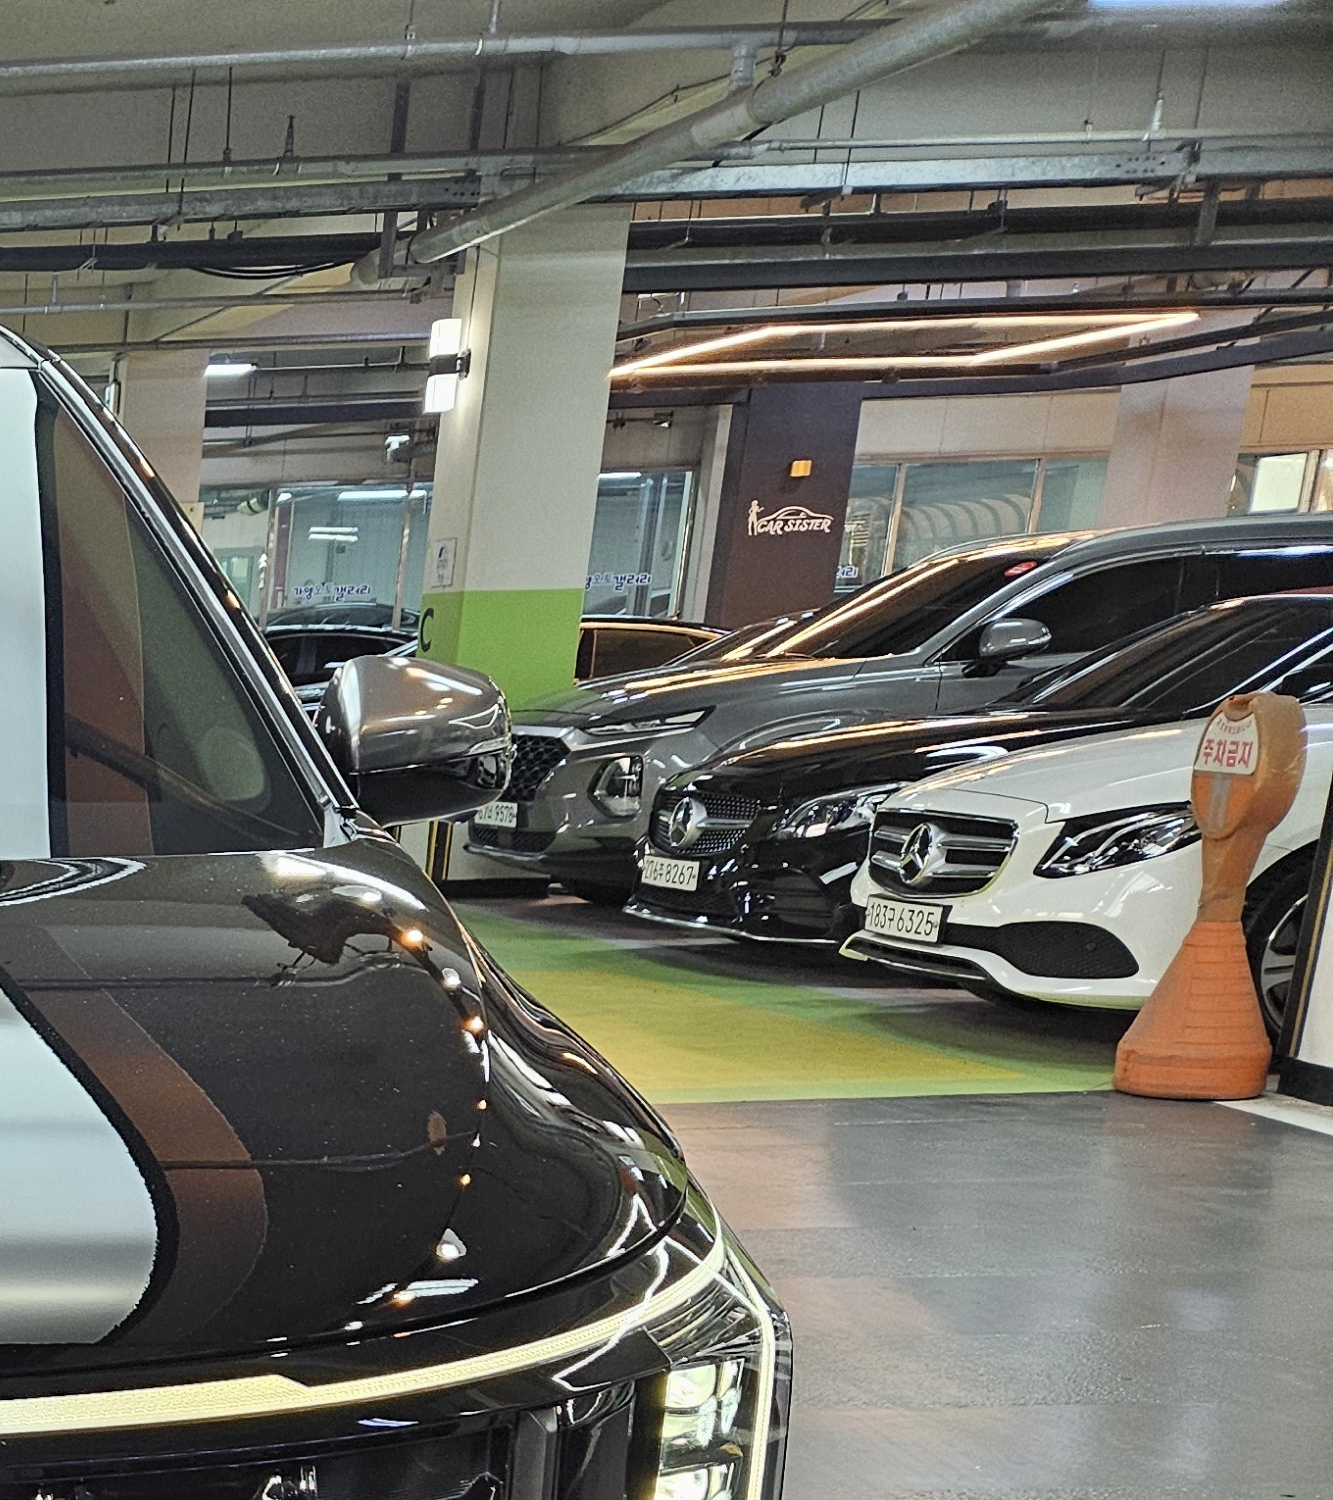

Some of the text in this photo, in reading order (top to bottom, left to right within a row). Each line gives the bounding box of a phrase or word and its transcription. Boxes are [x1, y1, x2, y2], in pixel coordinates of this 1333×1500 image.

[757, 519, 832, 535] CAR SISTER
[1203, 739, 1253, 768] 주차금지
[665, 863, 694, 885] 8267
[870, 902, 935, 936] 183구 6325
